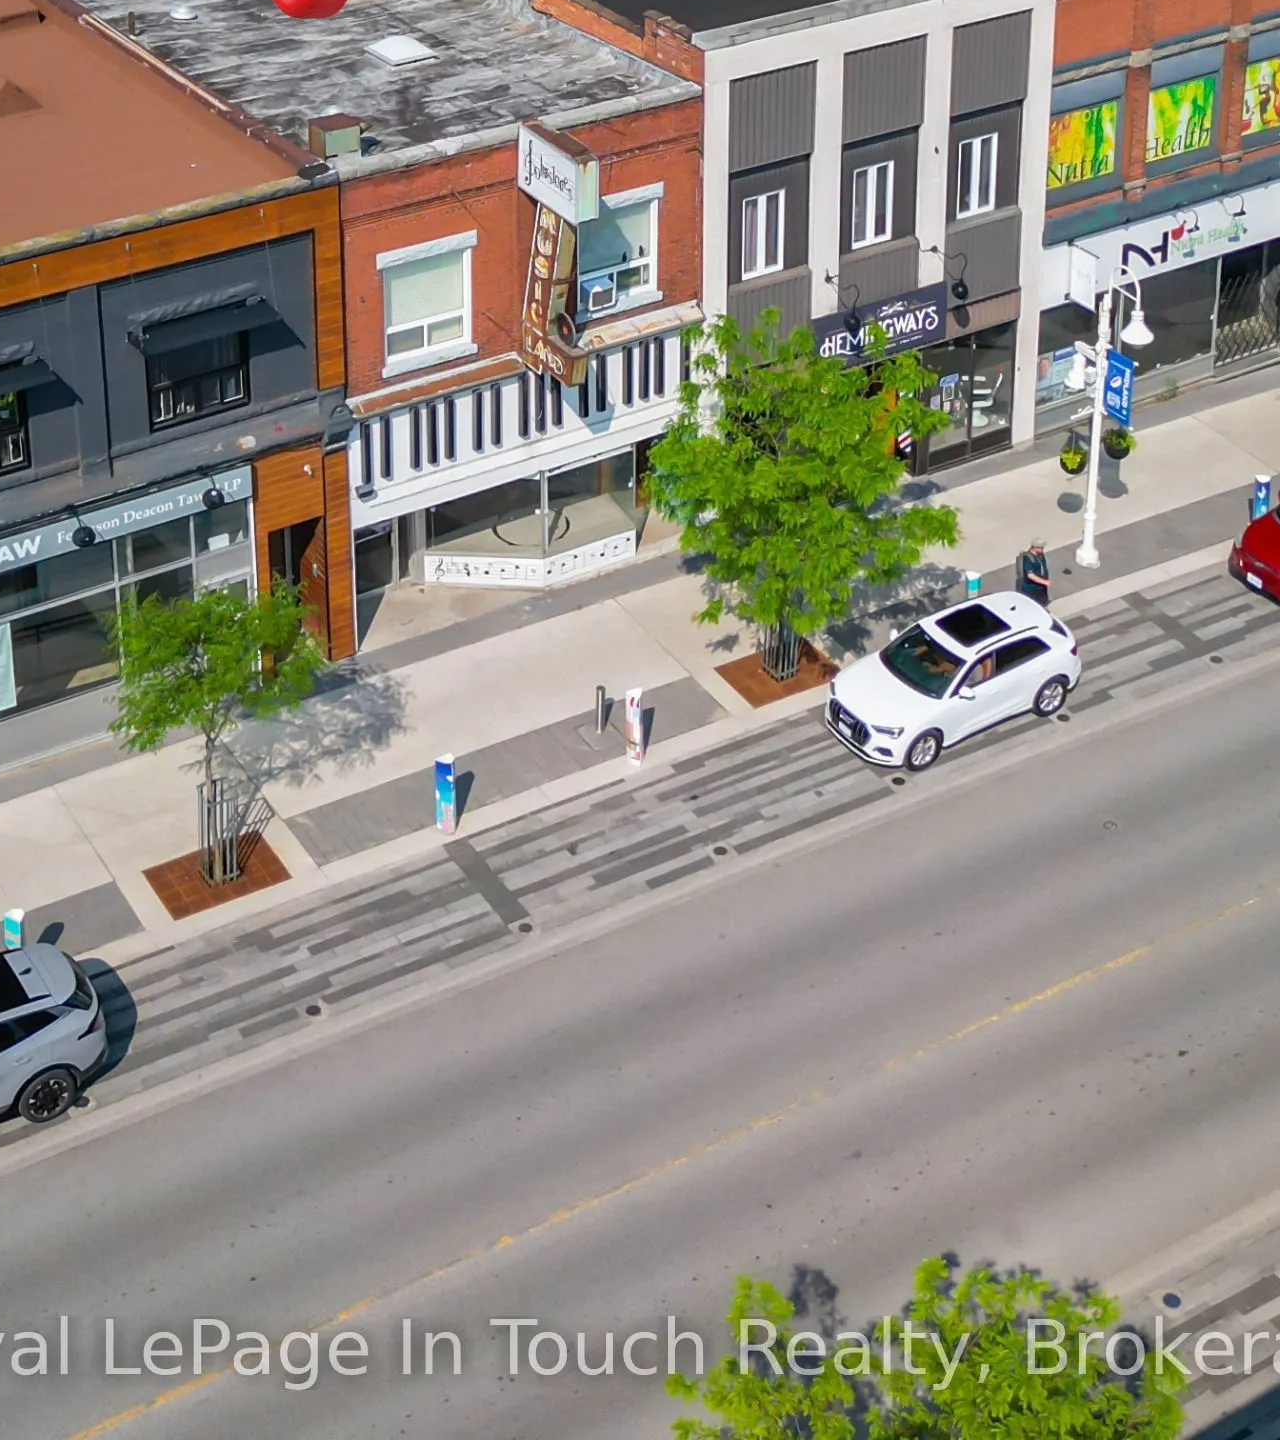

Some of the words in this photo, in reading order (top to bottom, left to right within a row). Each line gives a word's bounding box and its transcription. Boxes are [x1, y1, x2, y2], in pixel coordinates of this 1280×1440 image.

[1047, 152, 1110, 185] Nutra
[1143, 110, 1211, 160] Health
[123, 502, 174, 524] Deacon
